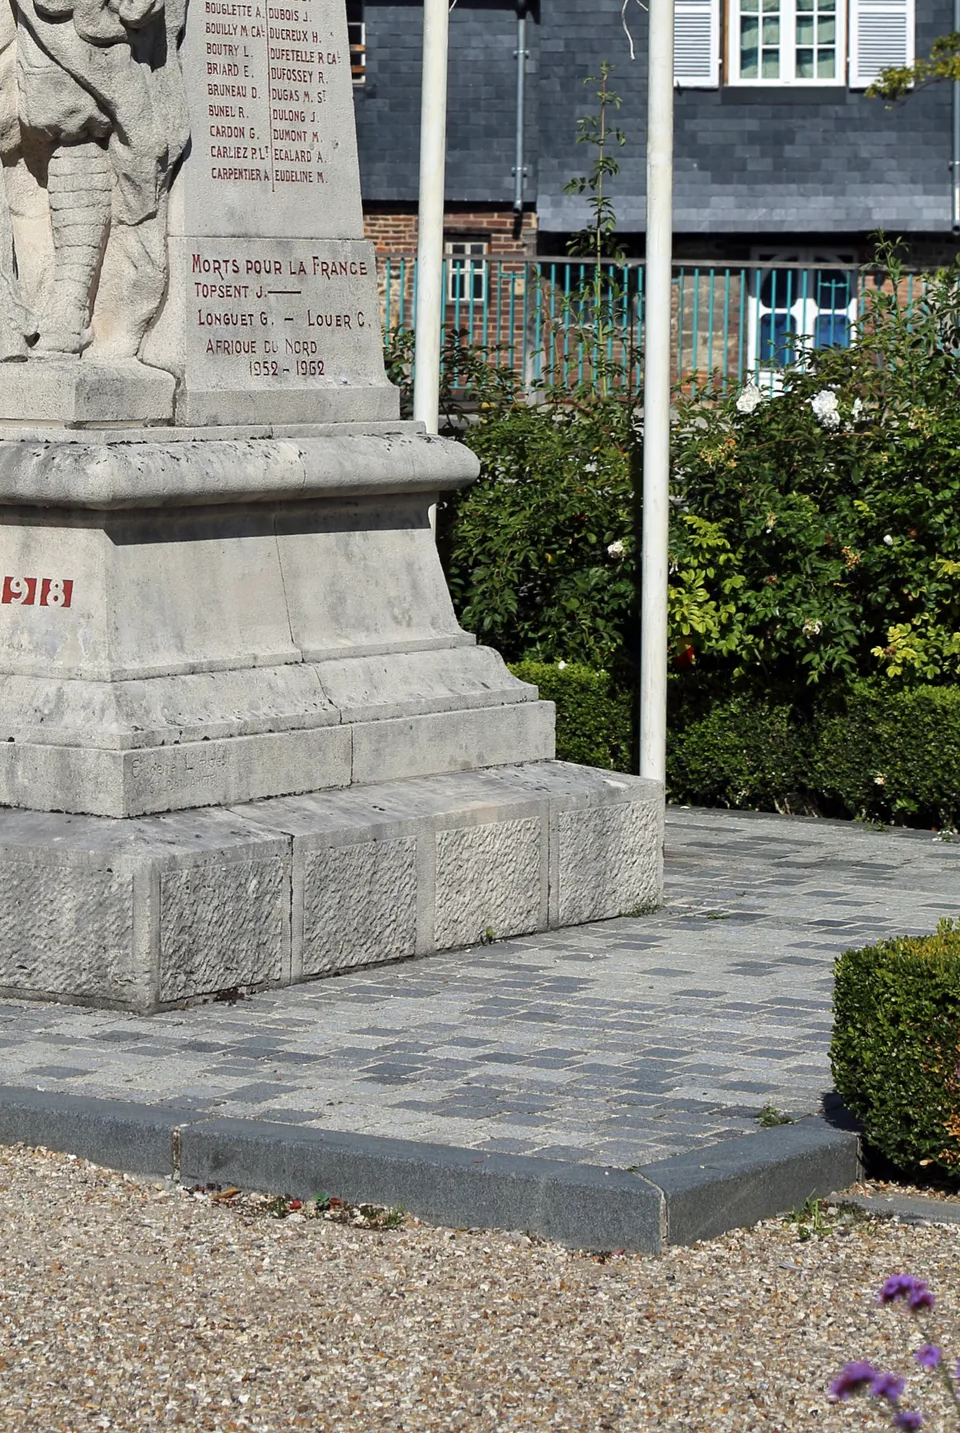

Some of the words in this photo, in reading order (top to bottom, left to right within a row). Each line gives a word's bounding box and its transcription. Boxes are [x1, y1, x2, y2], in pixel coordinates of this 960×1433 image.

[206, 2, 252, 17] BOUGLETTE
[269, 8, 299, 21] DUBOIS
[206, 23, 238, 36] BOUILLY
[270, 27, 308, 42] DUCREUX
[207, 43, 239, 57] BOUTRY
[271, 48, 314, 63] DUFETELLE
[207, 62, 238, 76] BRIARD
[271, 67, 313, 83] DUFOSSEY
[208, 83, 246, 97] BRUNEAU
[272, 88, 300, 102] DUGAS
[209, 105, 235, 117] BUNEL
[273, 109, 305, 122] DULONG
[210, 126, 245, 138] CARDON
[274, 129, 307, 142] DUMONT
[211, 146, 248, 159] CARLIEZ
[274, 149, 312, 163] ECALARD
[212, 168, 261, 181] CARPENTIER
[275, 169, 313, 183] EUDELINE
[195, 283, 248, 298] TOPSENT
[297, 360, 324, 376] 1962
